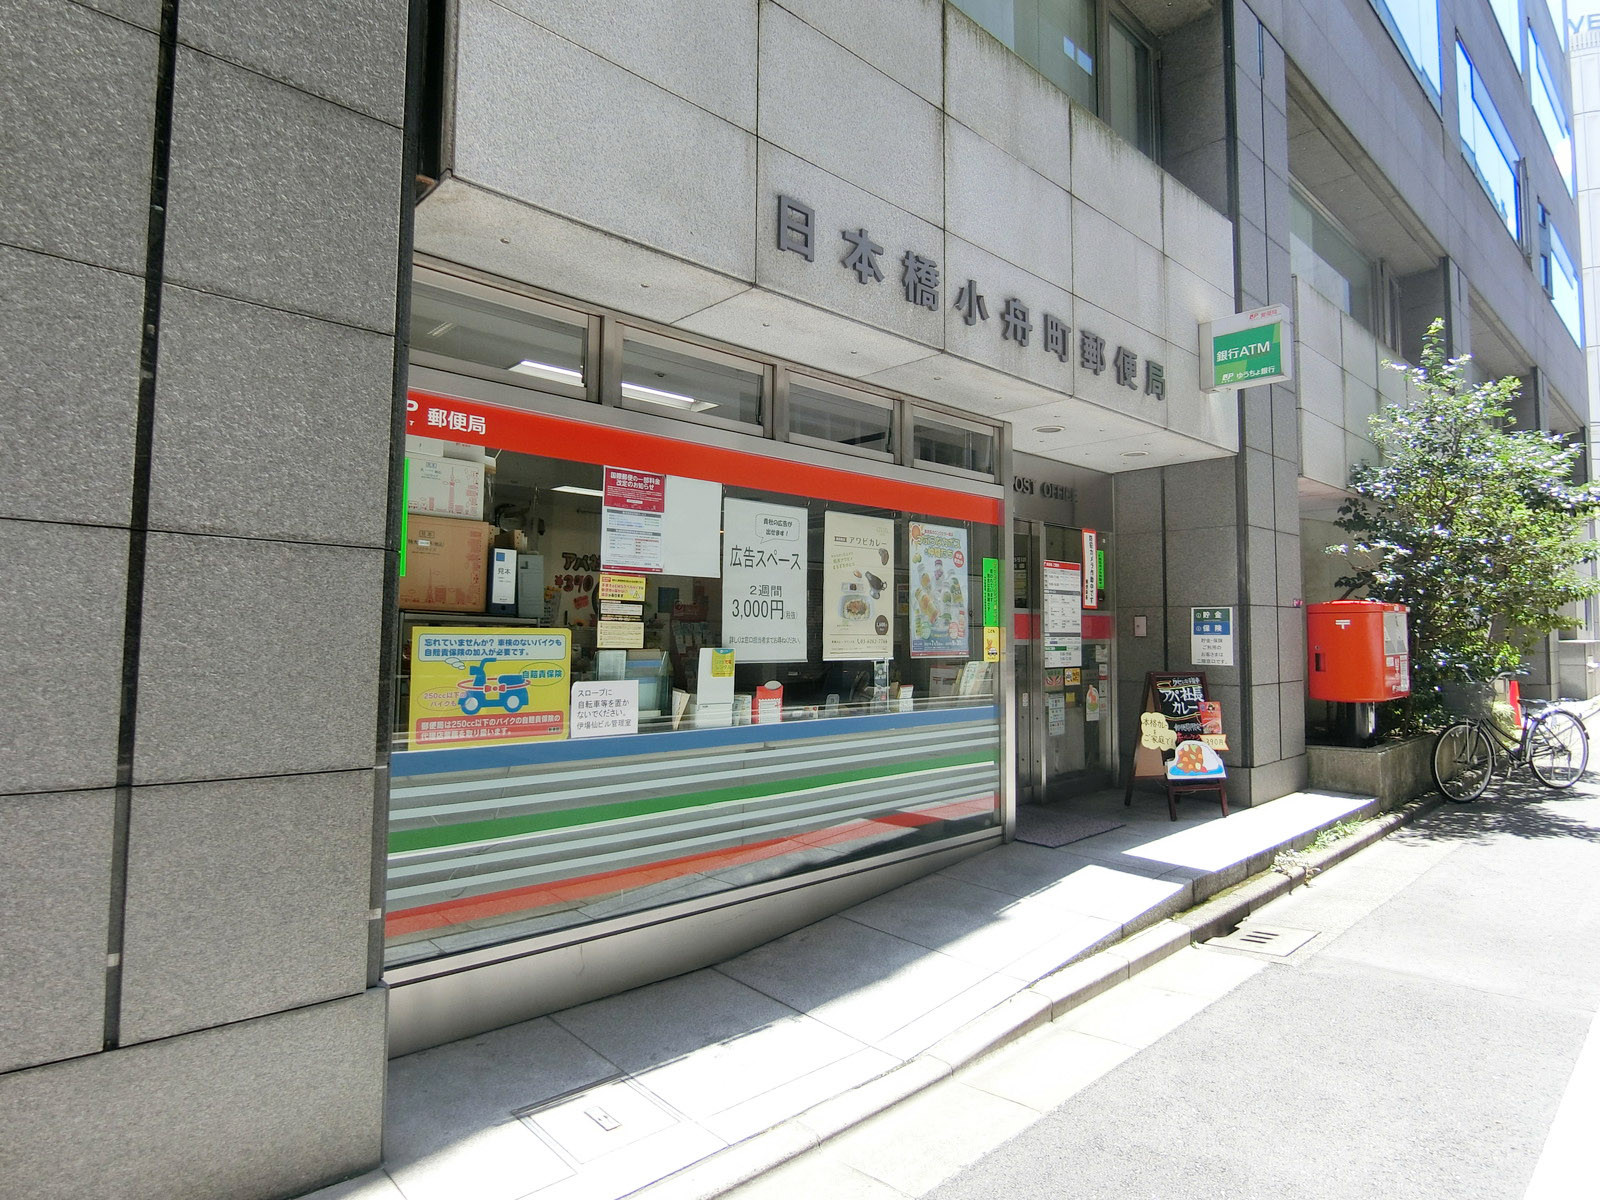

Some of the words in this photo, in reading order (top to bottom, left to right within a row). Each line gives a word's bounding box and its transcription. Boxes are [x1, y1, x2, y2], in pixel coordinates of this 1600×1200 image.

[777, 194, 1166, 401] 日本橋小舟町郵便局
[1216, 341, 1271, 362] 銀行ATM
[1236, 365, 1276, 378] ゆうちょ銀行
[427, 407, 487, 436] 郵便局
[1013, 476, 1034, 495] OST
[763, 517, 793, 528] 貴社の広告が
[849, 536, 888, 547] アワビカレー
[729, 544, 802, 571] 広告スペース
[749, 584, 783, 598] ２週間
[731, 598, 784, 620] 3,000円
[1202, 610, 1222, 619] 貯金
[424, 648, 530, 657] 自賠責保険の加入が必要です。
[522, 669, 563, 679] 自賠責保険
[423, 690, 468, 700] 250cc以下の
[1159, 686, 1205, 702] アパ社長
[430, 700, 457, 708] バイクも
[578, 698, 630, 709] 自転車等を置か
[1172, 701, 1199, 715] カレー
[577, 708, 627, 719] ないでください。
